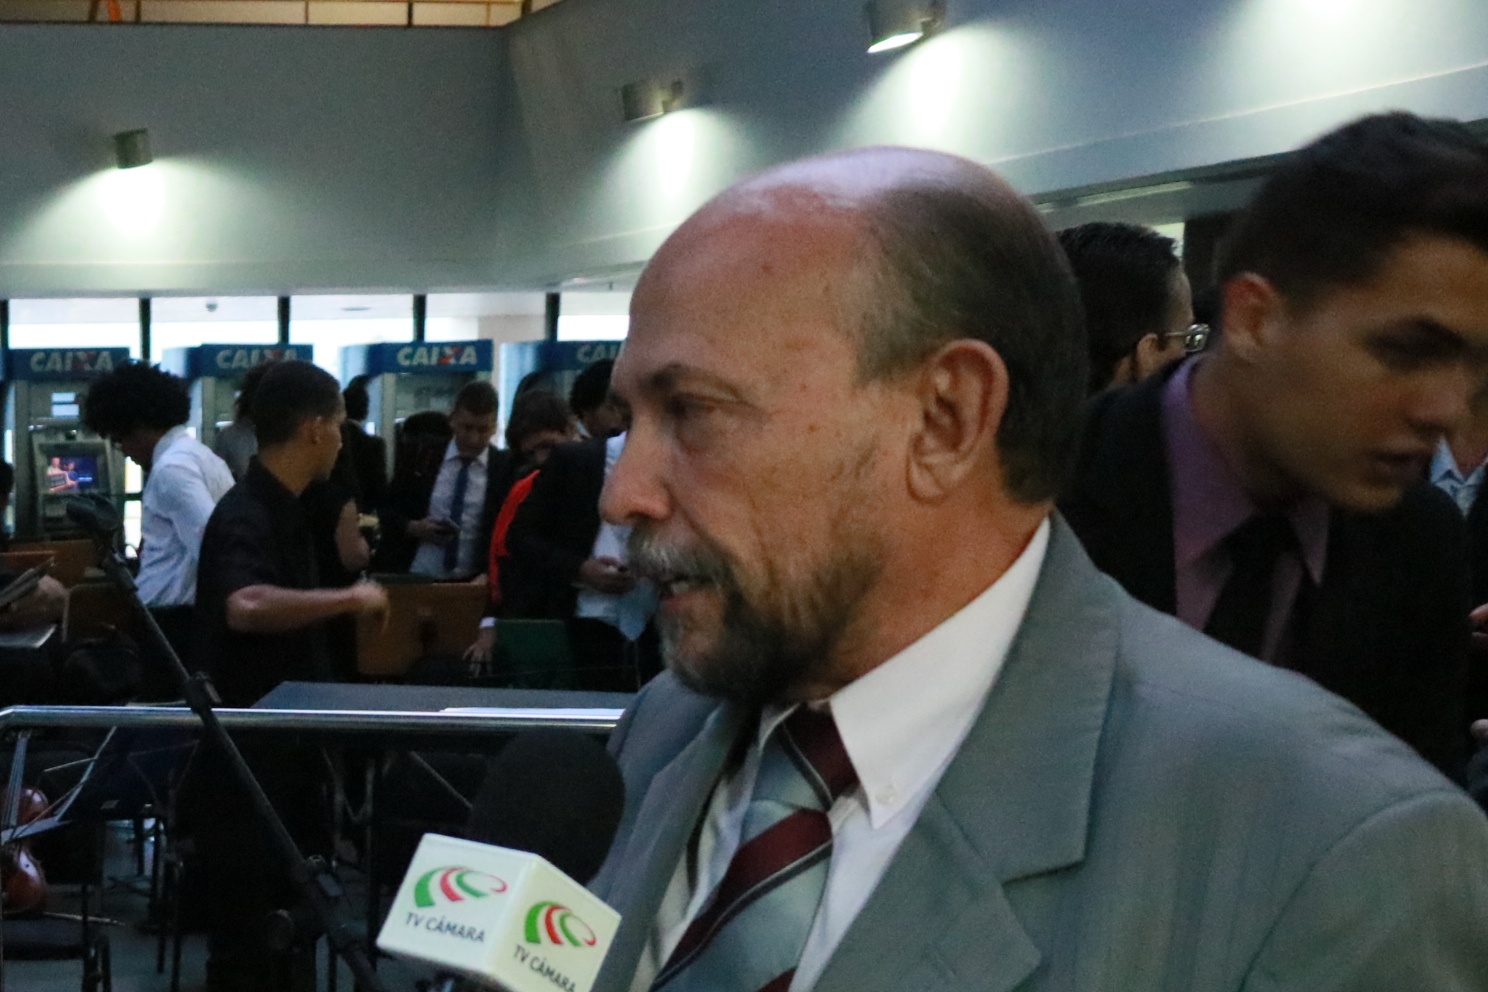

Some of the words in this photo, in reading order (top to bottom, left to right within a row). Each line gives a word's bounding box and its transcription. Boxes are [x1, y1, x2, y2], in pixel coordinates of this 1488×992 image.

[29, 350, 114, 372] CAIXA
[396, 345, 478, 366] CAIXA
[577, 344, 618, 362] CAI
[406, 912, 424, 927] TV
[426, 914, 485, 942] CÂMARA
[513, 944, 529, 962] TV
